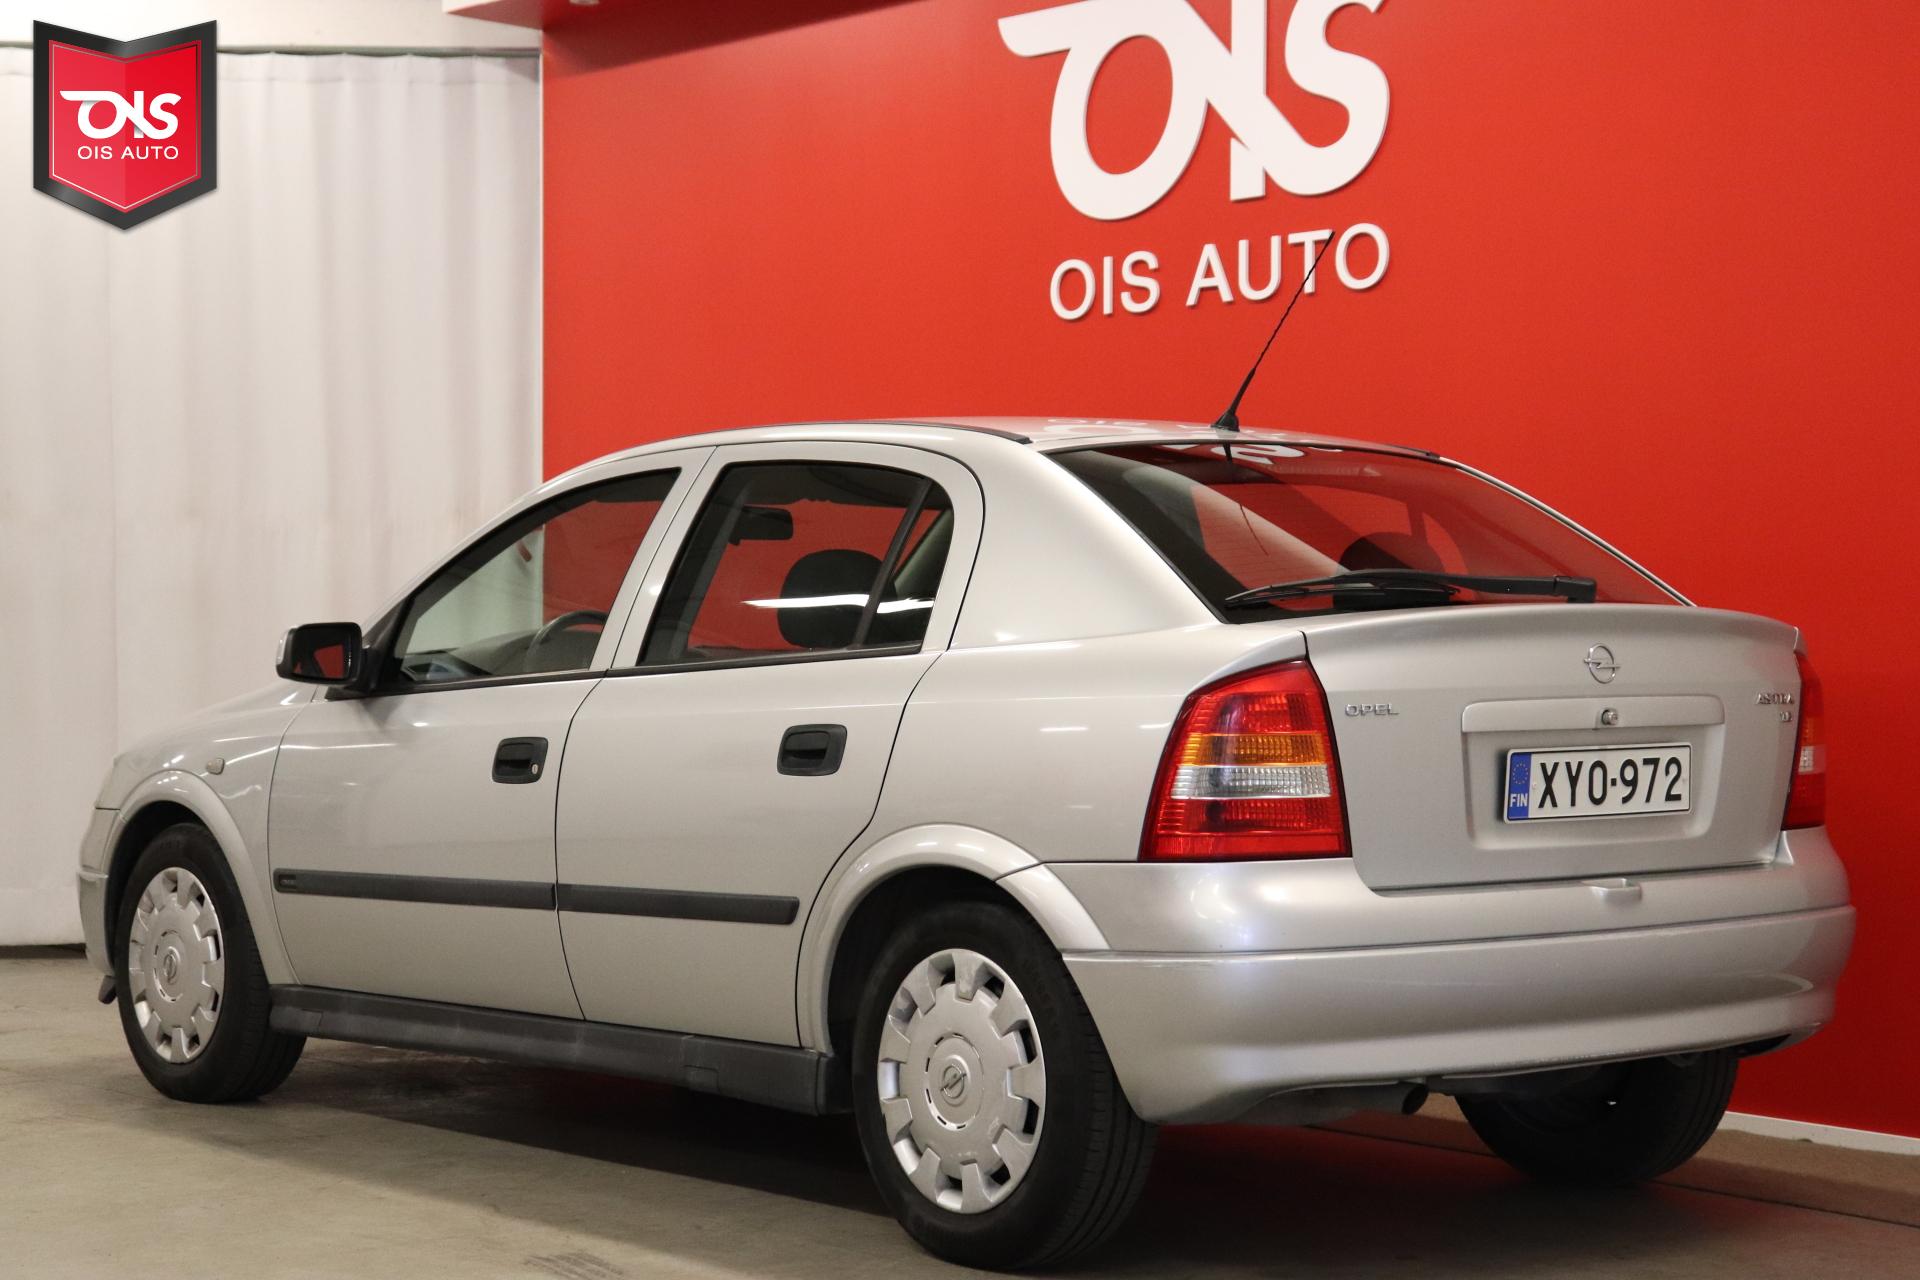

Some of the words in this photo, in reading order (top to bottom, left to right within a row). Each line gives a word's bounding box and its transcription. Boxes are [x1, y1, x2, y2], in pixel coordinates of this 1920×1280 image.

[1049, 250, 1161, 321] OIS
[1185, 223, 1391, 307] AUTO
[1344, 703, 1400, 717] OPEL
[1509, 793, 1528, 808] FIN
